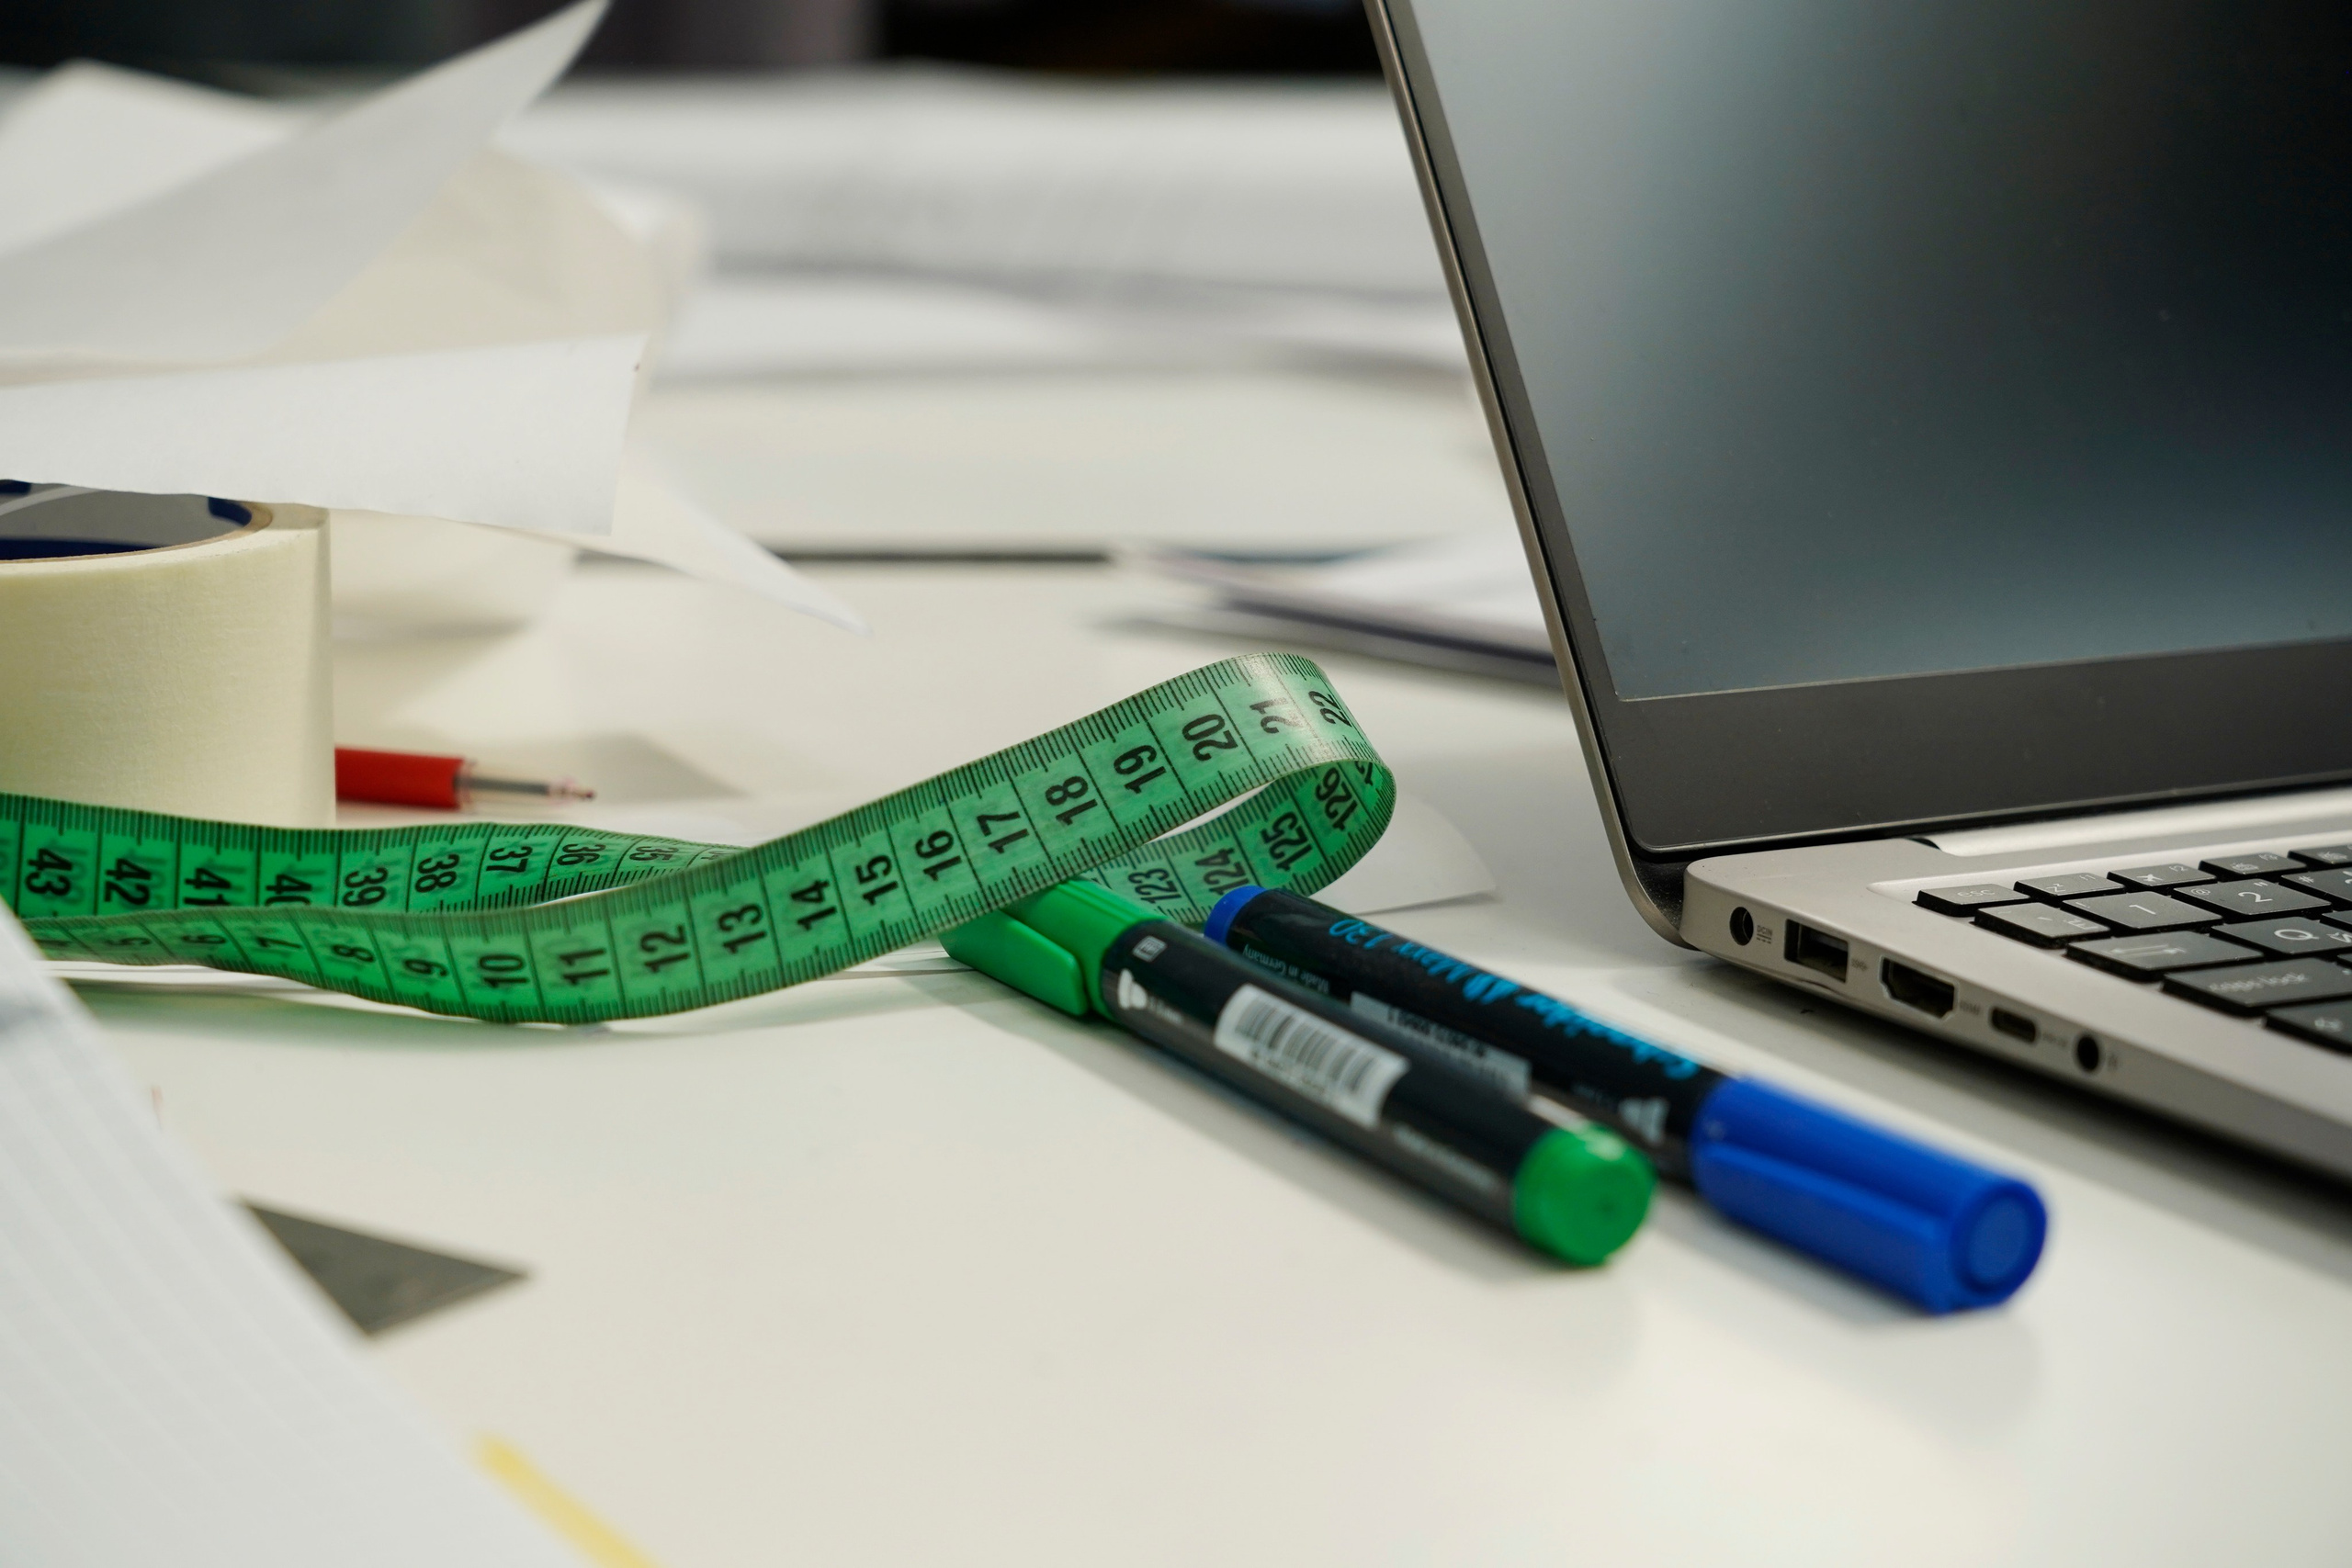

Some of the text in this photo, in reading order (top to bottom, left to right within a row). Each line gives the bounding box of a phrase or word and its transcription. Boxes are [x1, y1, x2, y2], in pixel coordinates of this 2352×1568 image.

[1250, 696, 1304, 734] 21
[1308, 691, 1352, 728] 22
[1182, 714, 1238, 761] 20
[1114, 744, 1166, 794] 19
[1045, 775, 1098, 826] 18
[1315, 767, 1359, 830] 126
[977, 811, 1029, 854] 17
[1261, 811, 1313, 872] 125
[25, 848, 74, 897] 43
[415, 853, 459, 894] 38
[486, 845, 533, 874] 37
[557, 842, 605, 866] 36
[629, 846, 679, 861] 35
[914, 830, 963, 882] 16
[1195, 846, 1250, 897] 124
[104, 858, 152, 906] 42
[184, 867, 232, 907] 41
[343, 867, 388, 907] 39
[855, 854, 899, 906] 15
[1128, 867, 1182, 905] 123
[1958, 889, 1996, 897] esc
[2238, 891, 2273, 903] 2
[791, 879, 838, 932] 14
[2129, 904, 2156, 915] 1
[256, 936, 301, 948] 7
[639, 923, 691, 974] 12
[718, 903, 767, 955] 13
[2274, 929, 2320, 941] Q
[331, 944, 375, 963] 8
[402, 959, 448, 977] 9
[479, 953, 529, 988] 10
[557, 947, 610, 987] 11
[1242, 943, 1286, 974] Germany
